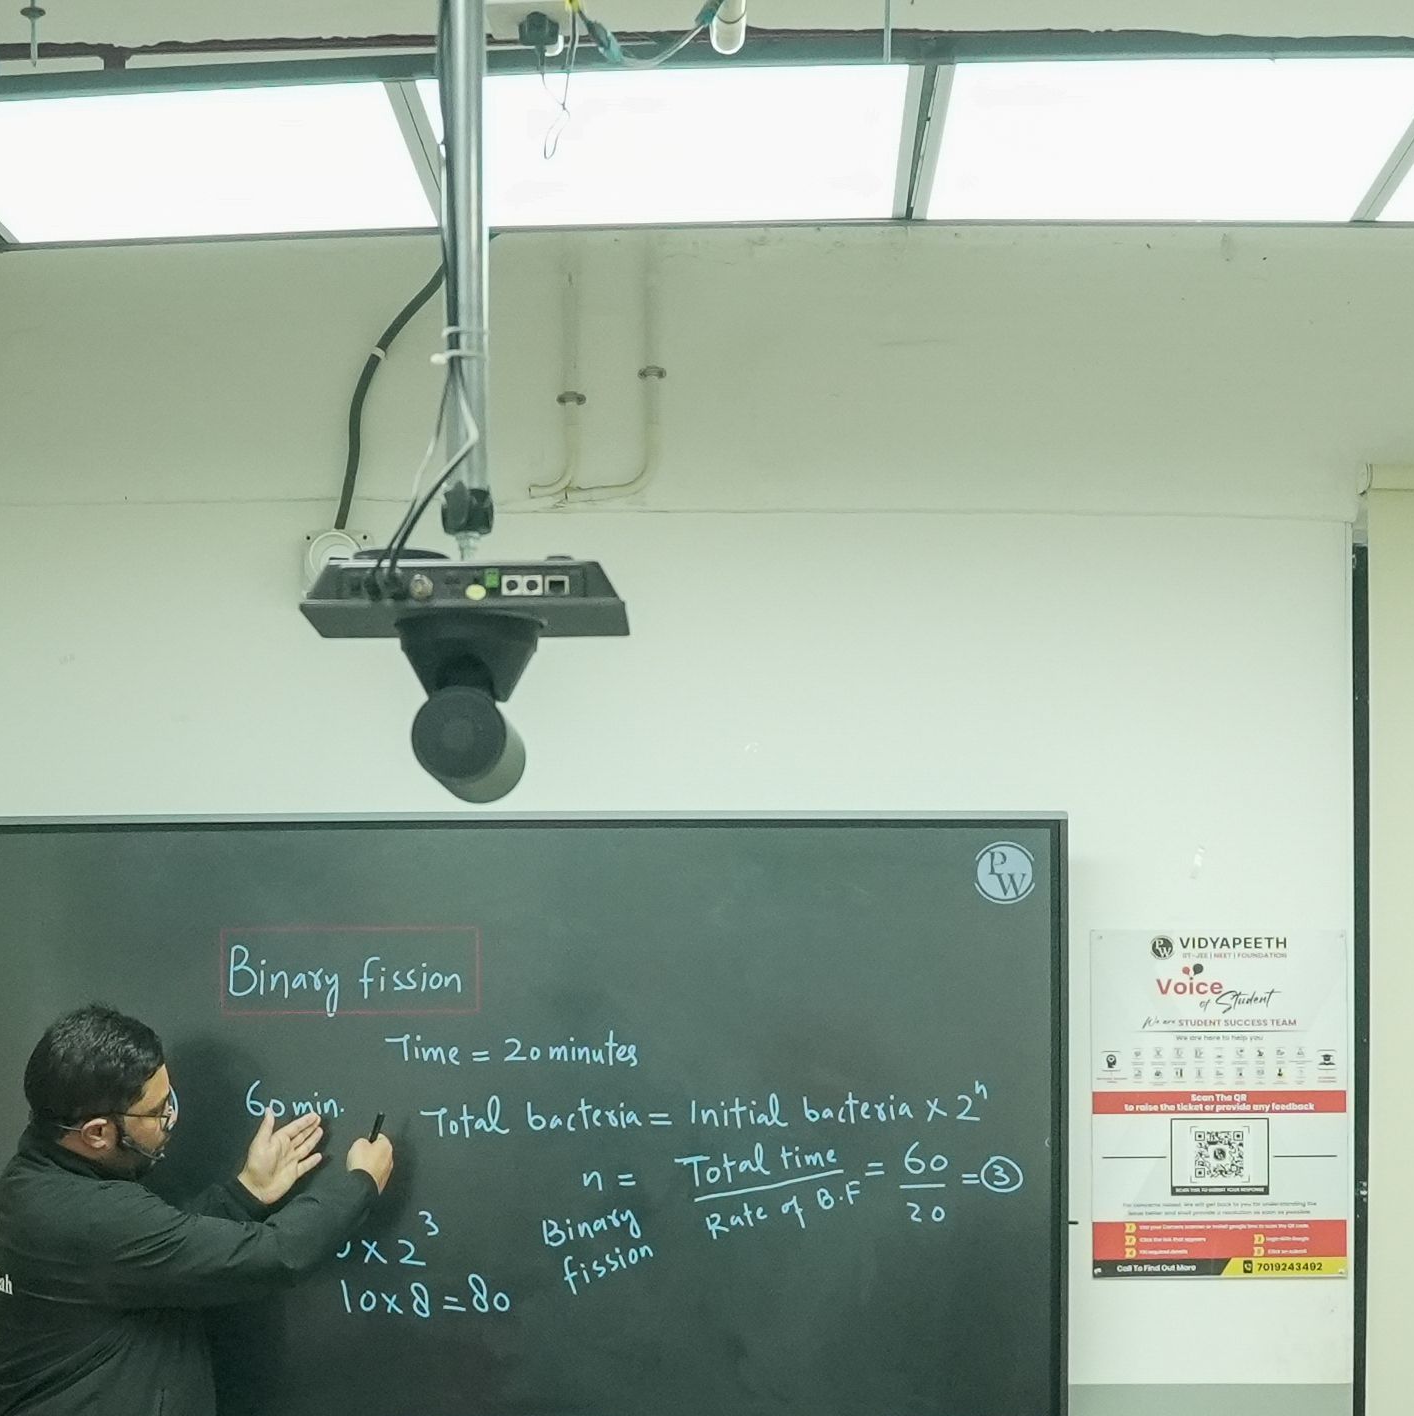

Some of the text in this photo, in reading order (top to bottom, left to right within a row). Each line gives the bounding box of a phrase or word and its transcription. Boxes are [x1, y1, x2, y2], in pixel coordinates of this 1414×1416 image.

[1179, 937, 1287, 949] VIDYAPEETH
[228, 944, 462, 1018] Binary fission
[1156, 977, 1223, 995] Voice
[1199, 988, 1282, 1014] of Student
[1178, 1019, 1221, 1027] STUDENT
[385, 1034, 460, 1066] Time
[504, 1038, 541, 1061] 20
[549, 1030, 638, 1067] minutes
[246, 1080, 286, 1118] 60
[420, 1095, 510, 1138] Total
[527, 1098, 642, 1132] bacteria
[691, 1093, 789, 1128] Initial
[802, 1092, 914, 1124] bacteria
[1160, 1103, 1175, 1111] the
[1176, 1103, 1203, 1111] ticket
[1215, 1103, 1252, 1112] provide
[1253, 1103, 1270, 1112] any
[1272, 1102, 1314, 1110] feedback
[1233, 1094, 1247, 1102] QR
[674, 1142, 771, 1187] Total
[781, 1146, 837, 1169] time
[904, 1141, 948, 1175] 60
[582, 1171, 603, 1191] n
[542, 1208, 641, 1247] Binary
[706, 1202, 768, 1240] Rate
[781, 1195, 805, 1229] of
[907, 1202, 945, 1223] 20
[563, 1244, 654, 1295] fission
